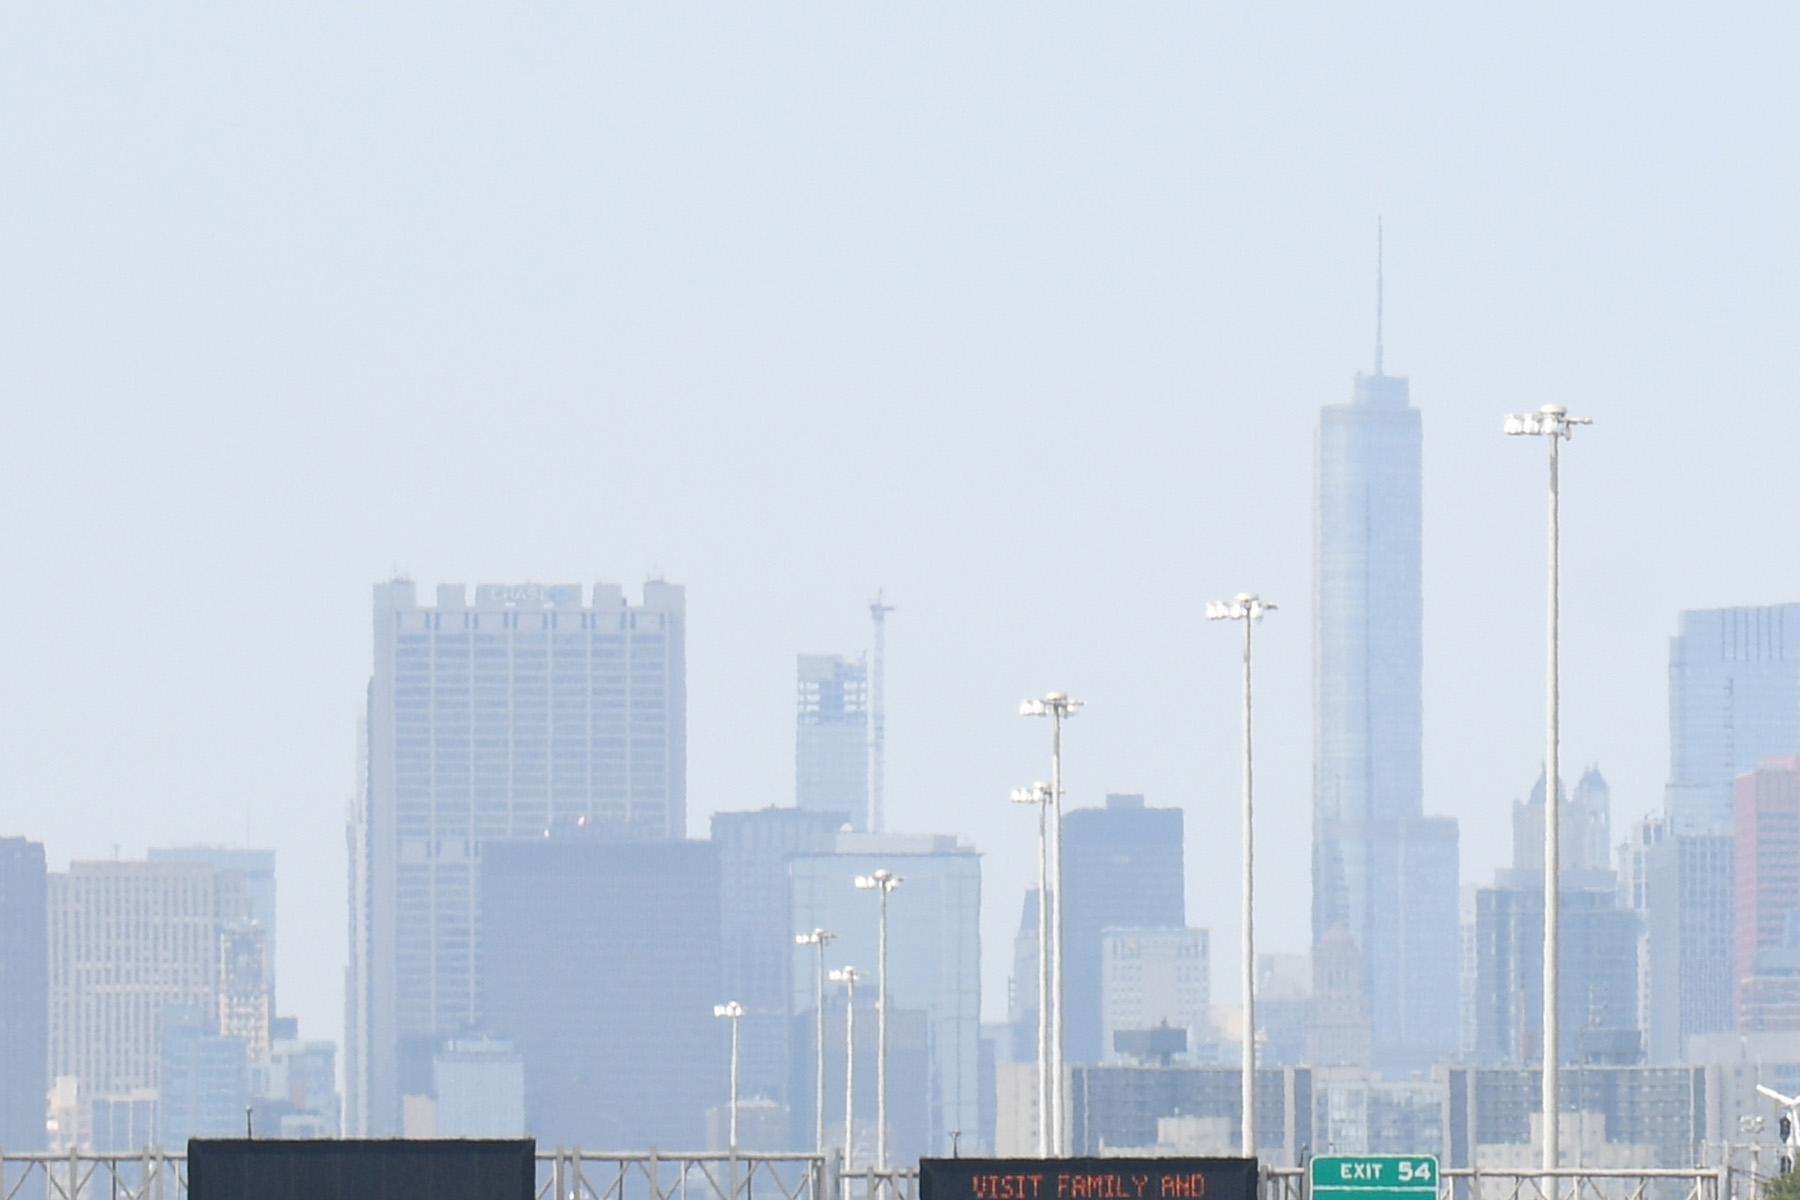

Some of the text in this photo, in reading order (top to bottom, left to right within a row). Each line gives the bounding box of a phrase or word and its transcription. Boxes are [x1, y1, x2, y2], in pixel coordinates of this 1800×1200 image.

[1340, 1161, 1431, 1181] EXIT 54
[972, 1174, 1205, 1198] VISIT FAMILY AND
